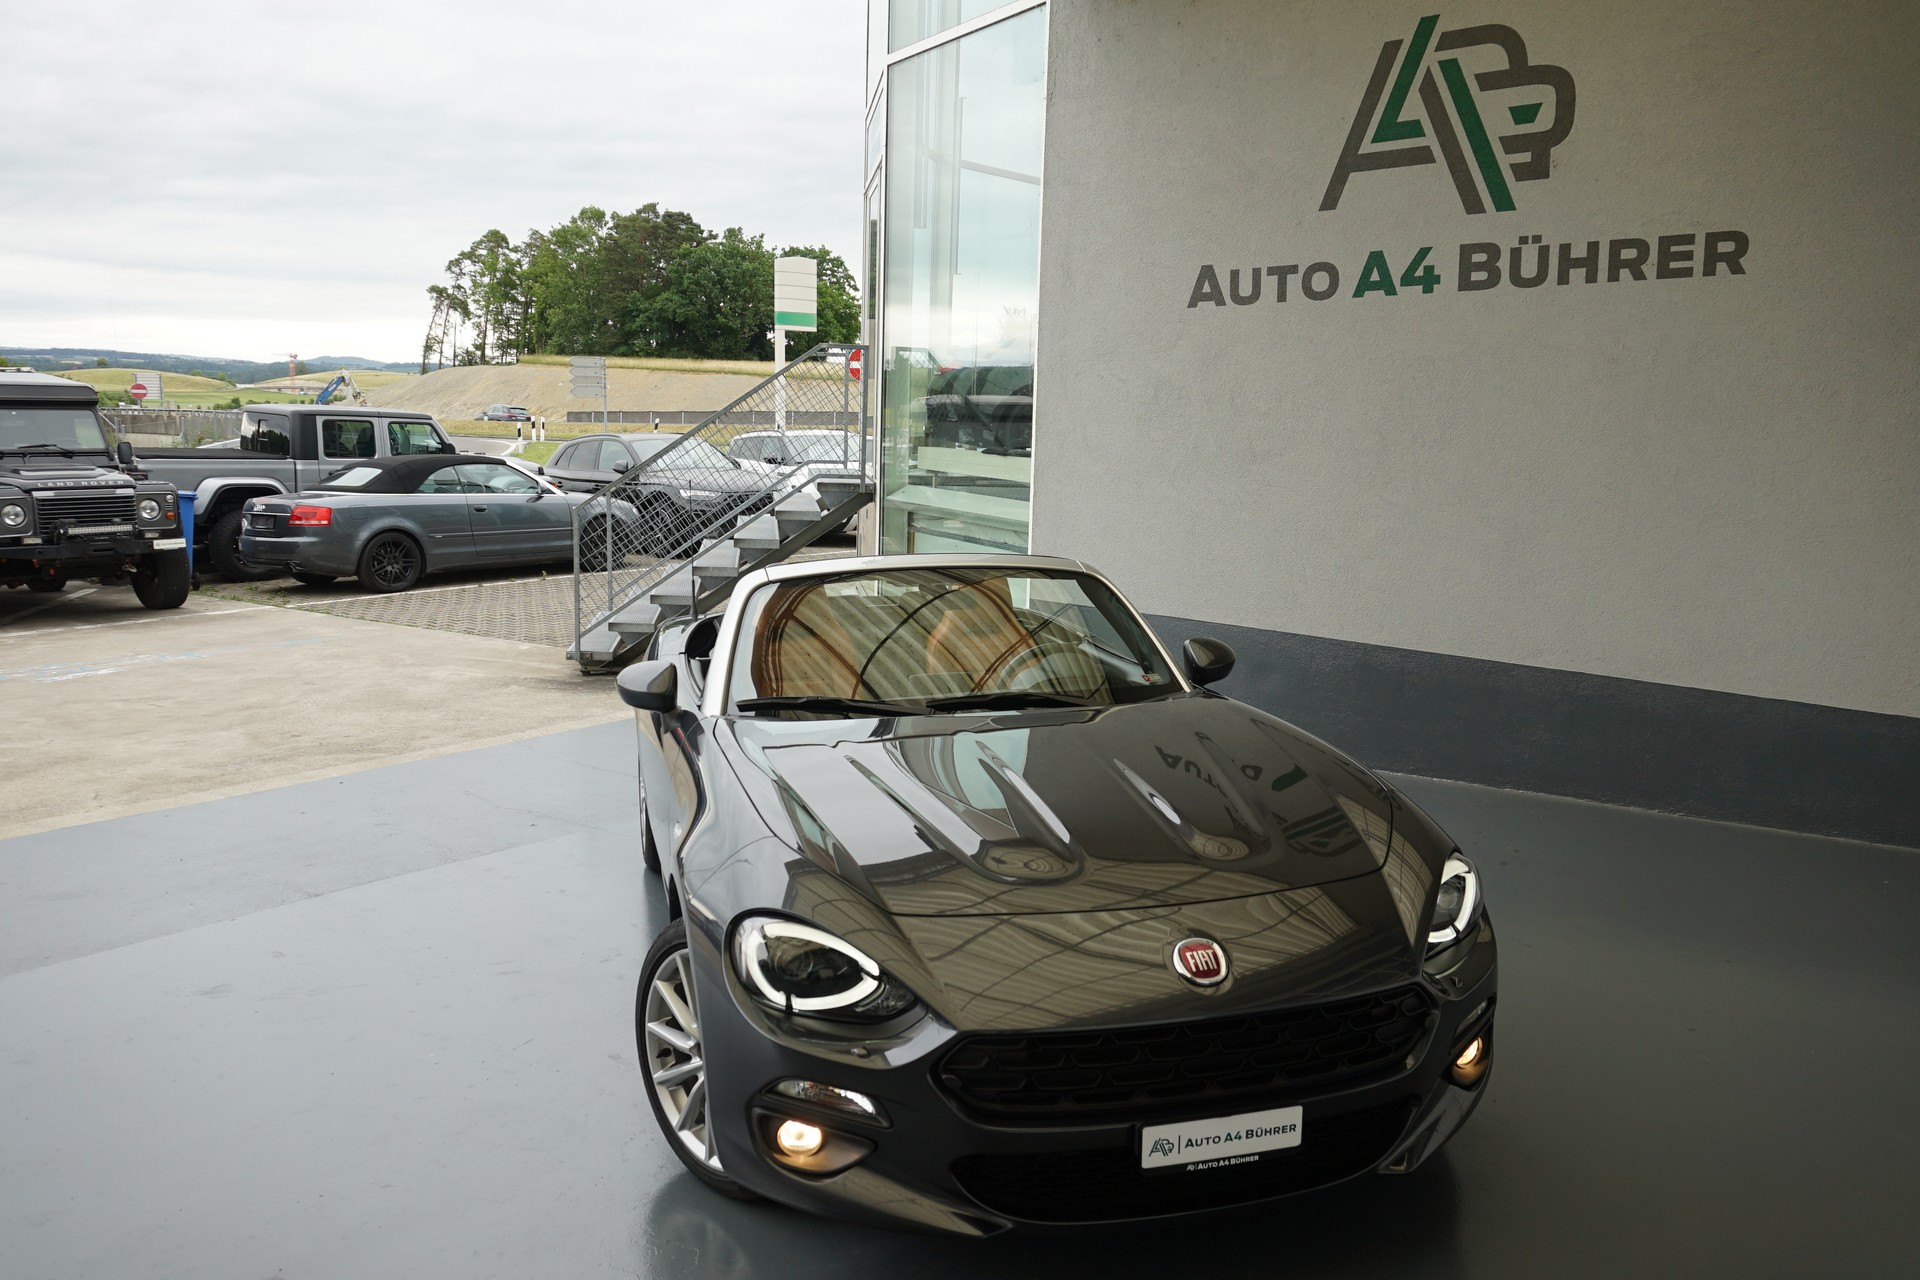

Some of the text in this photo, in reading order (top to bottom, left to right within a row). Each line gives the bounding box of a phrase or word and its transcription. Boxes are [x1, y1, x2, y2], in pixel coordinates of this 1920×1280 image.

[1187, 229, 1750, 308] AUTO A4 BÜHRER
[81, 479, 126, 487] ROVER
[1185, 949, 1218, 973] FIAT
[1184, 1135, 1222, 1149] AUTO
[1224, 1130, 1242, 1143] A4
[1245, 1123, 1297, 1140] BÜHRER
[1197, 1160, 1218, 1170] AUTO
[1219, 1158, 1230, 1167] A4
[1230, 1154, 1260, 1165] BÜHRER
